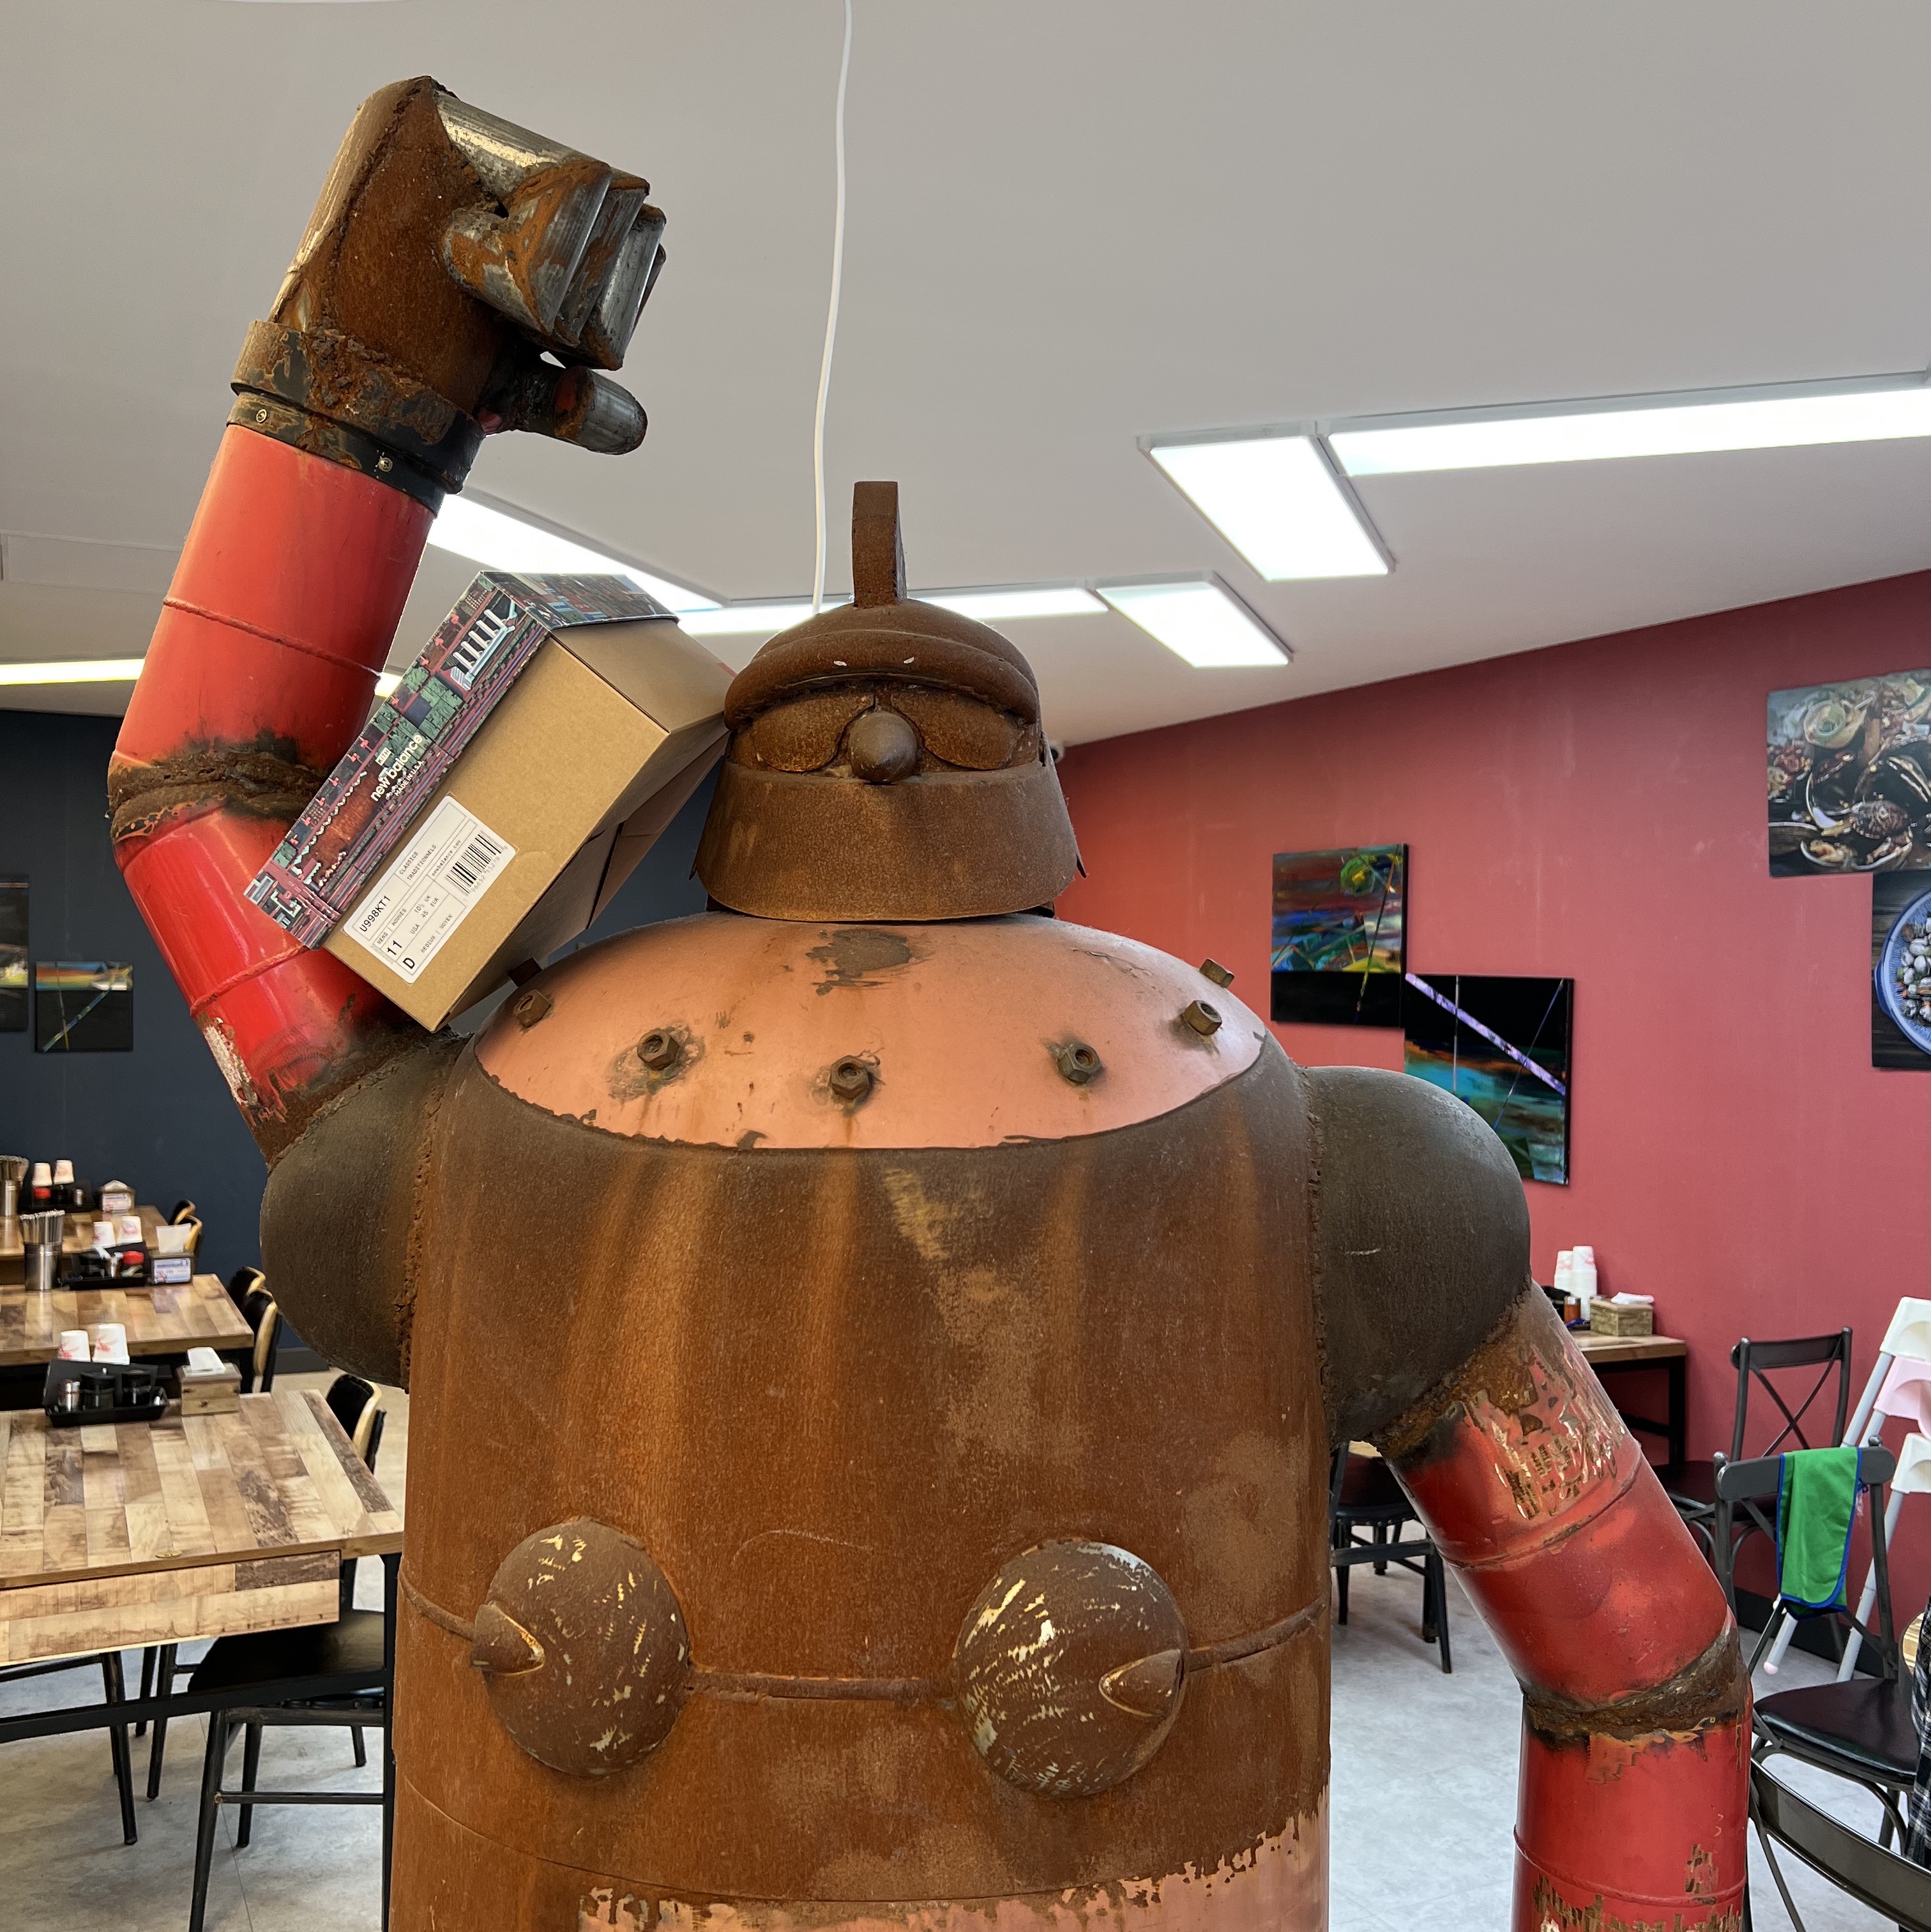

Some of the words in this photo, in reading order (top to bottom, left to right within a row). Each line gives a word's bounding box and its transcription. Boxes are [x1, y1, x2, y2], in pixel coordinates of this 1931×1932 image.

[371, 777, 391, 802] new
[386, 734, 422, 779] balance
[376, 748, 391, 764] KITH
[394, 780, 409, 796] MADE
[405, 772, 413, 782] IN
[399, 851, 418, 874] CLASSICS
[407, 844, 437, 881] TRADITIONNELS
[471, 875, 485, 892] 96652
[359, 895, 391, 932] U998KT1
[421, 910, 428, 918] 45
[430, 897, 439, 907] EUR
[387, 939, 402, 955] 11
[410, 924, 420, 934] USA
[423, 894, 431, 902] UK
[402, 957, 416, 970] D
[420, 935, 435, 953] MEDIUM
